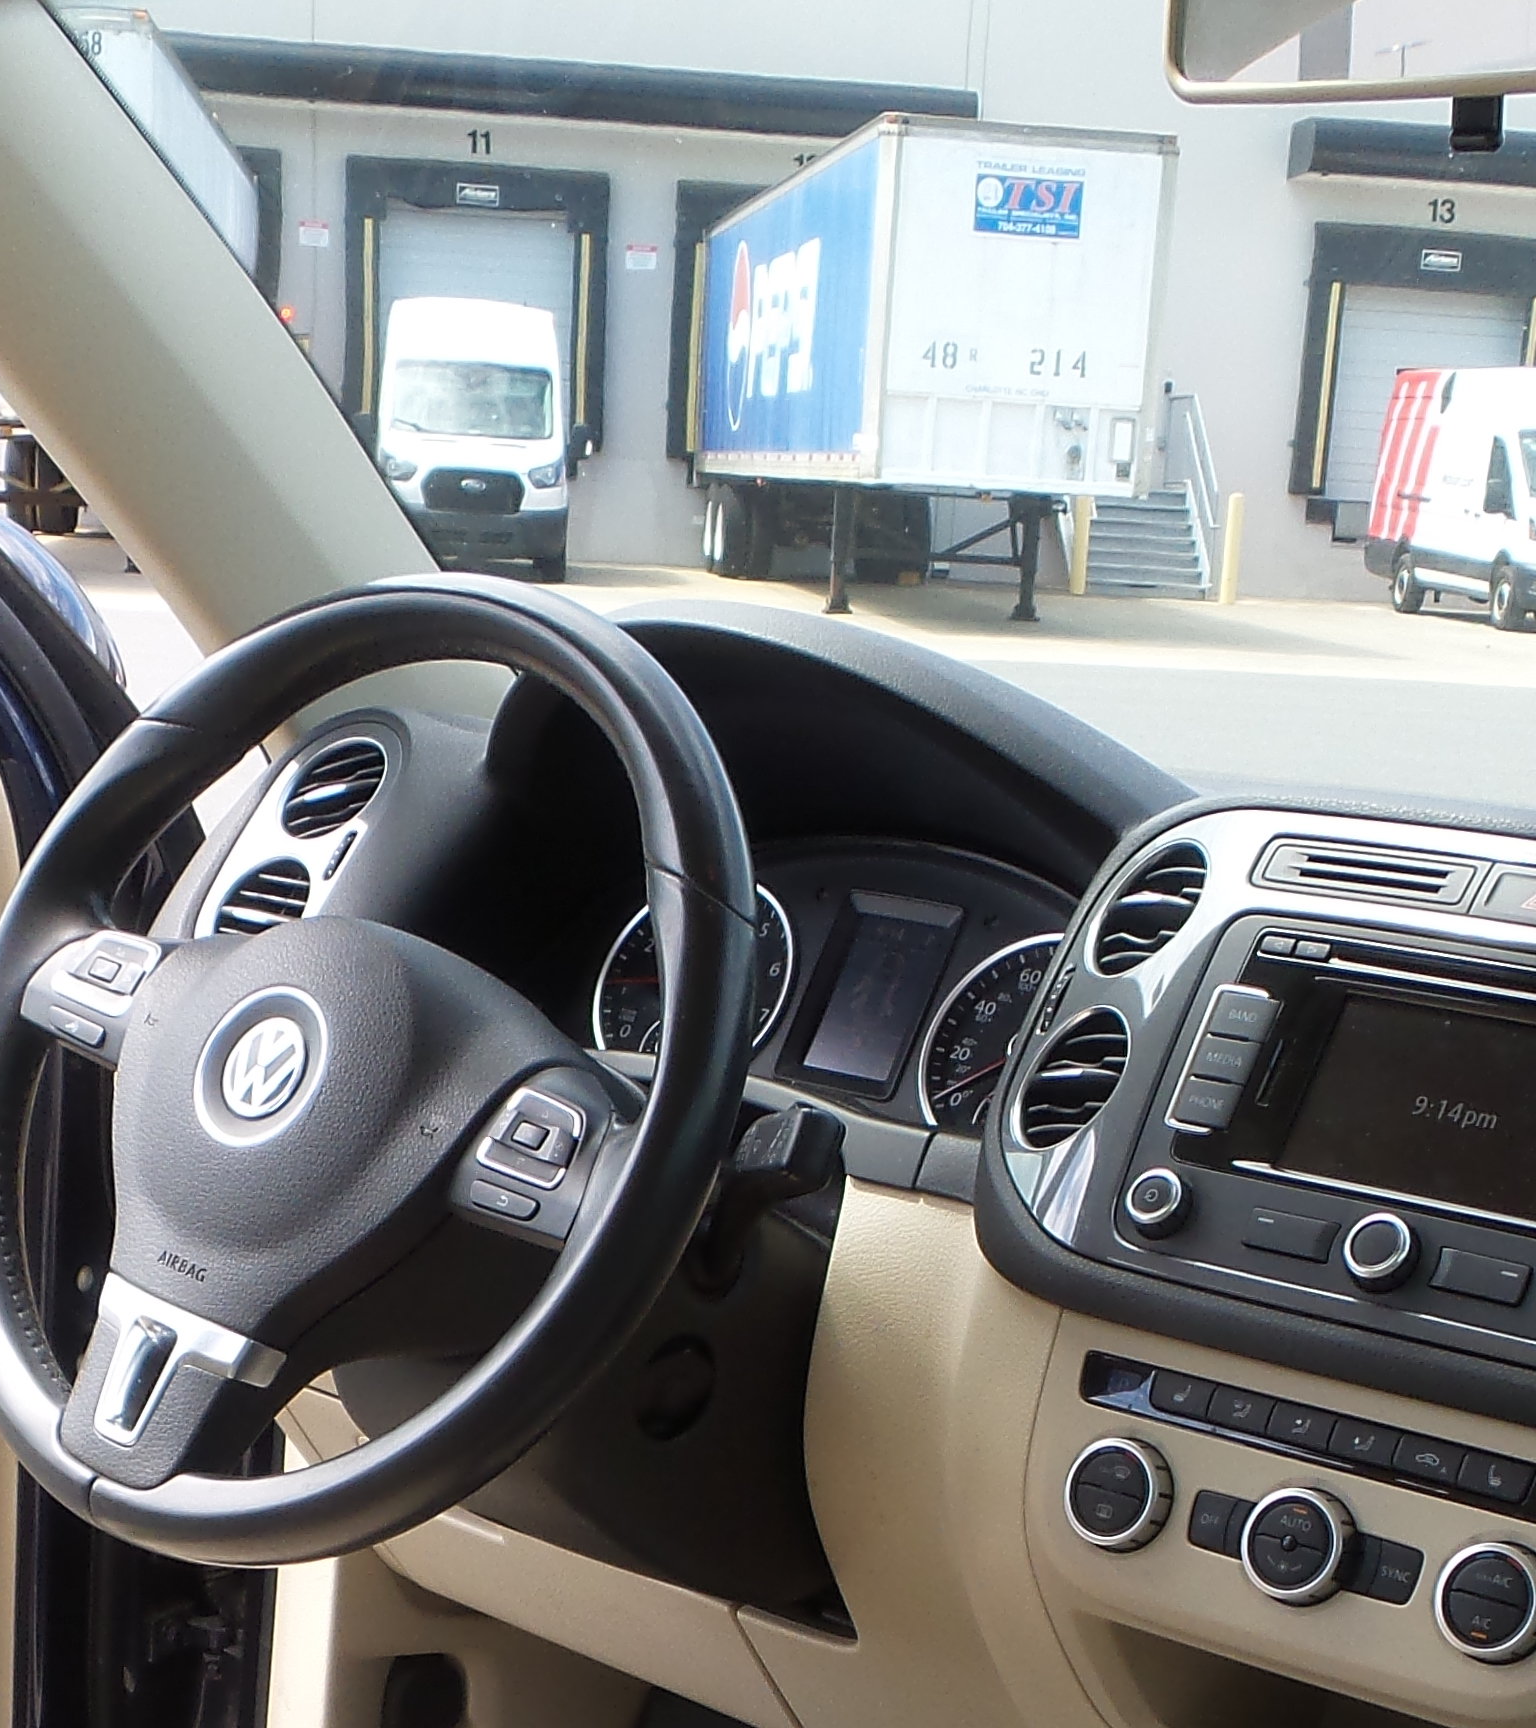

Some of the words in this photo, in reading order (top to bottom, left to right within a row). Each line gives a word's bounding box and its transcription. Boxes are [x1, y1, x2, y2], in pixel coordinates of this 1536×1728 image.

[468, 129, 491, 154] 11
[976, 160, 1027, 173] TRAILER
[1032, 165, 1086, 177] LEASING
[1004, 177, 1080, 214] TSI
[1427, 198, 1456, 223] 13
[922, 341, 958, 370] 48
[1029, 348, 1087, 378] 214
[759, 923, 770, 937] 5
[769, 962, 780, 976] 6
[1020, 968, 1042, 984] 60
[758, 1008, 770, 1022] 7
[974, 1000, 997, 1015] 40
[619, 1024, 631, 1038] 0
[949, 1045, 971, 1060] 20
[950, 1092, 962, 1106] 0
[1412, 1096, 1497, 1129] 9:14pm
[157, 1250, 207, 1282] AIRBAG
[1280, 1514, 1312, 1532] AUTO
[1380, 1564, 1411, 1583] SYNC
[1471, 1615, 1492, 1630] A/C
